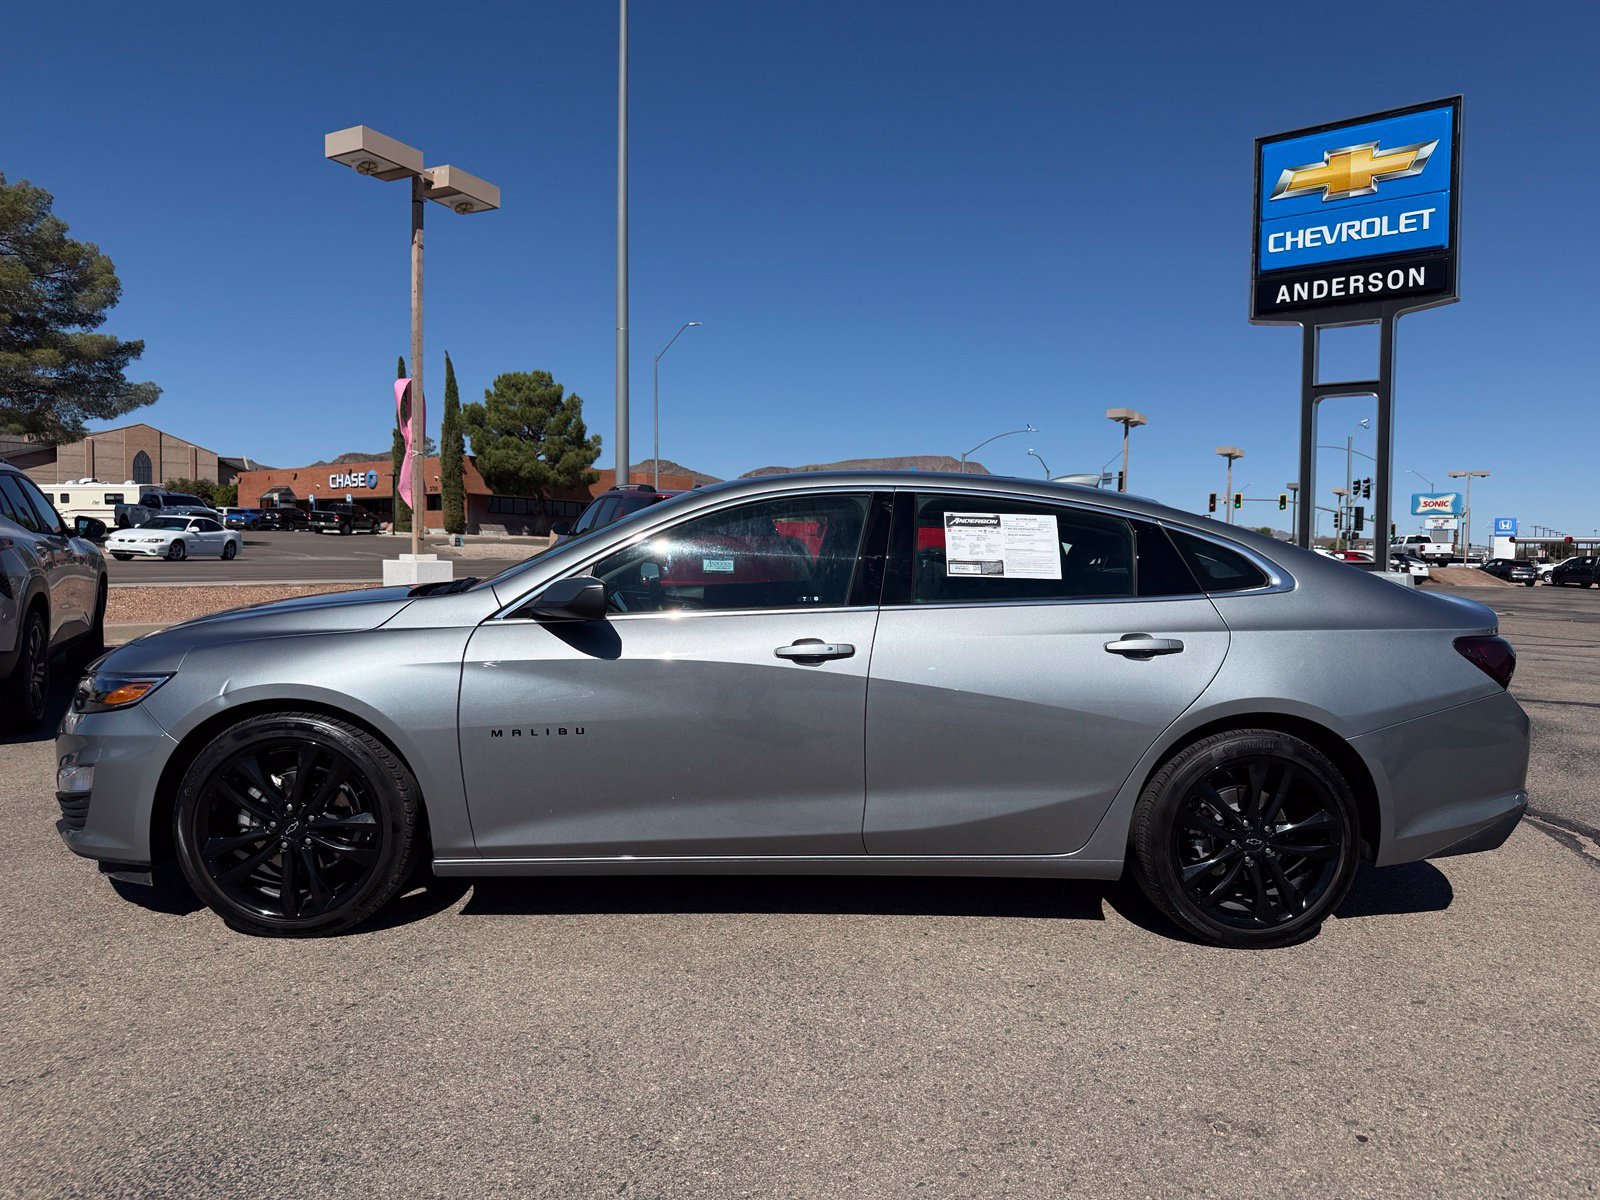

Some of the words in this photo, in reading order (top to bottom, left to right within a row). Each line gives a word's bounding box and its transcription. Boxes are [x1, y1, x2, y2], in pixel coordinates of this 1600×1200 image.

[1268, 207, 1436, 253] CHEVROLET
[1275, 266, 1426, 304] ANDERSON
[329, 472, 367, 488] CHASE
[1422, 500, 1450, 508] SONIC
[949, 517, 998, 525] ANDERSON
[491, 726, 585, 738] MALIBU
